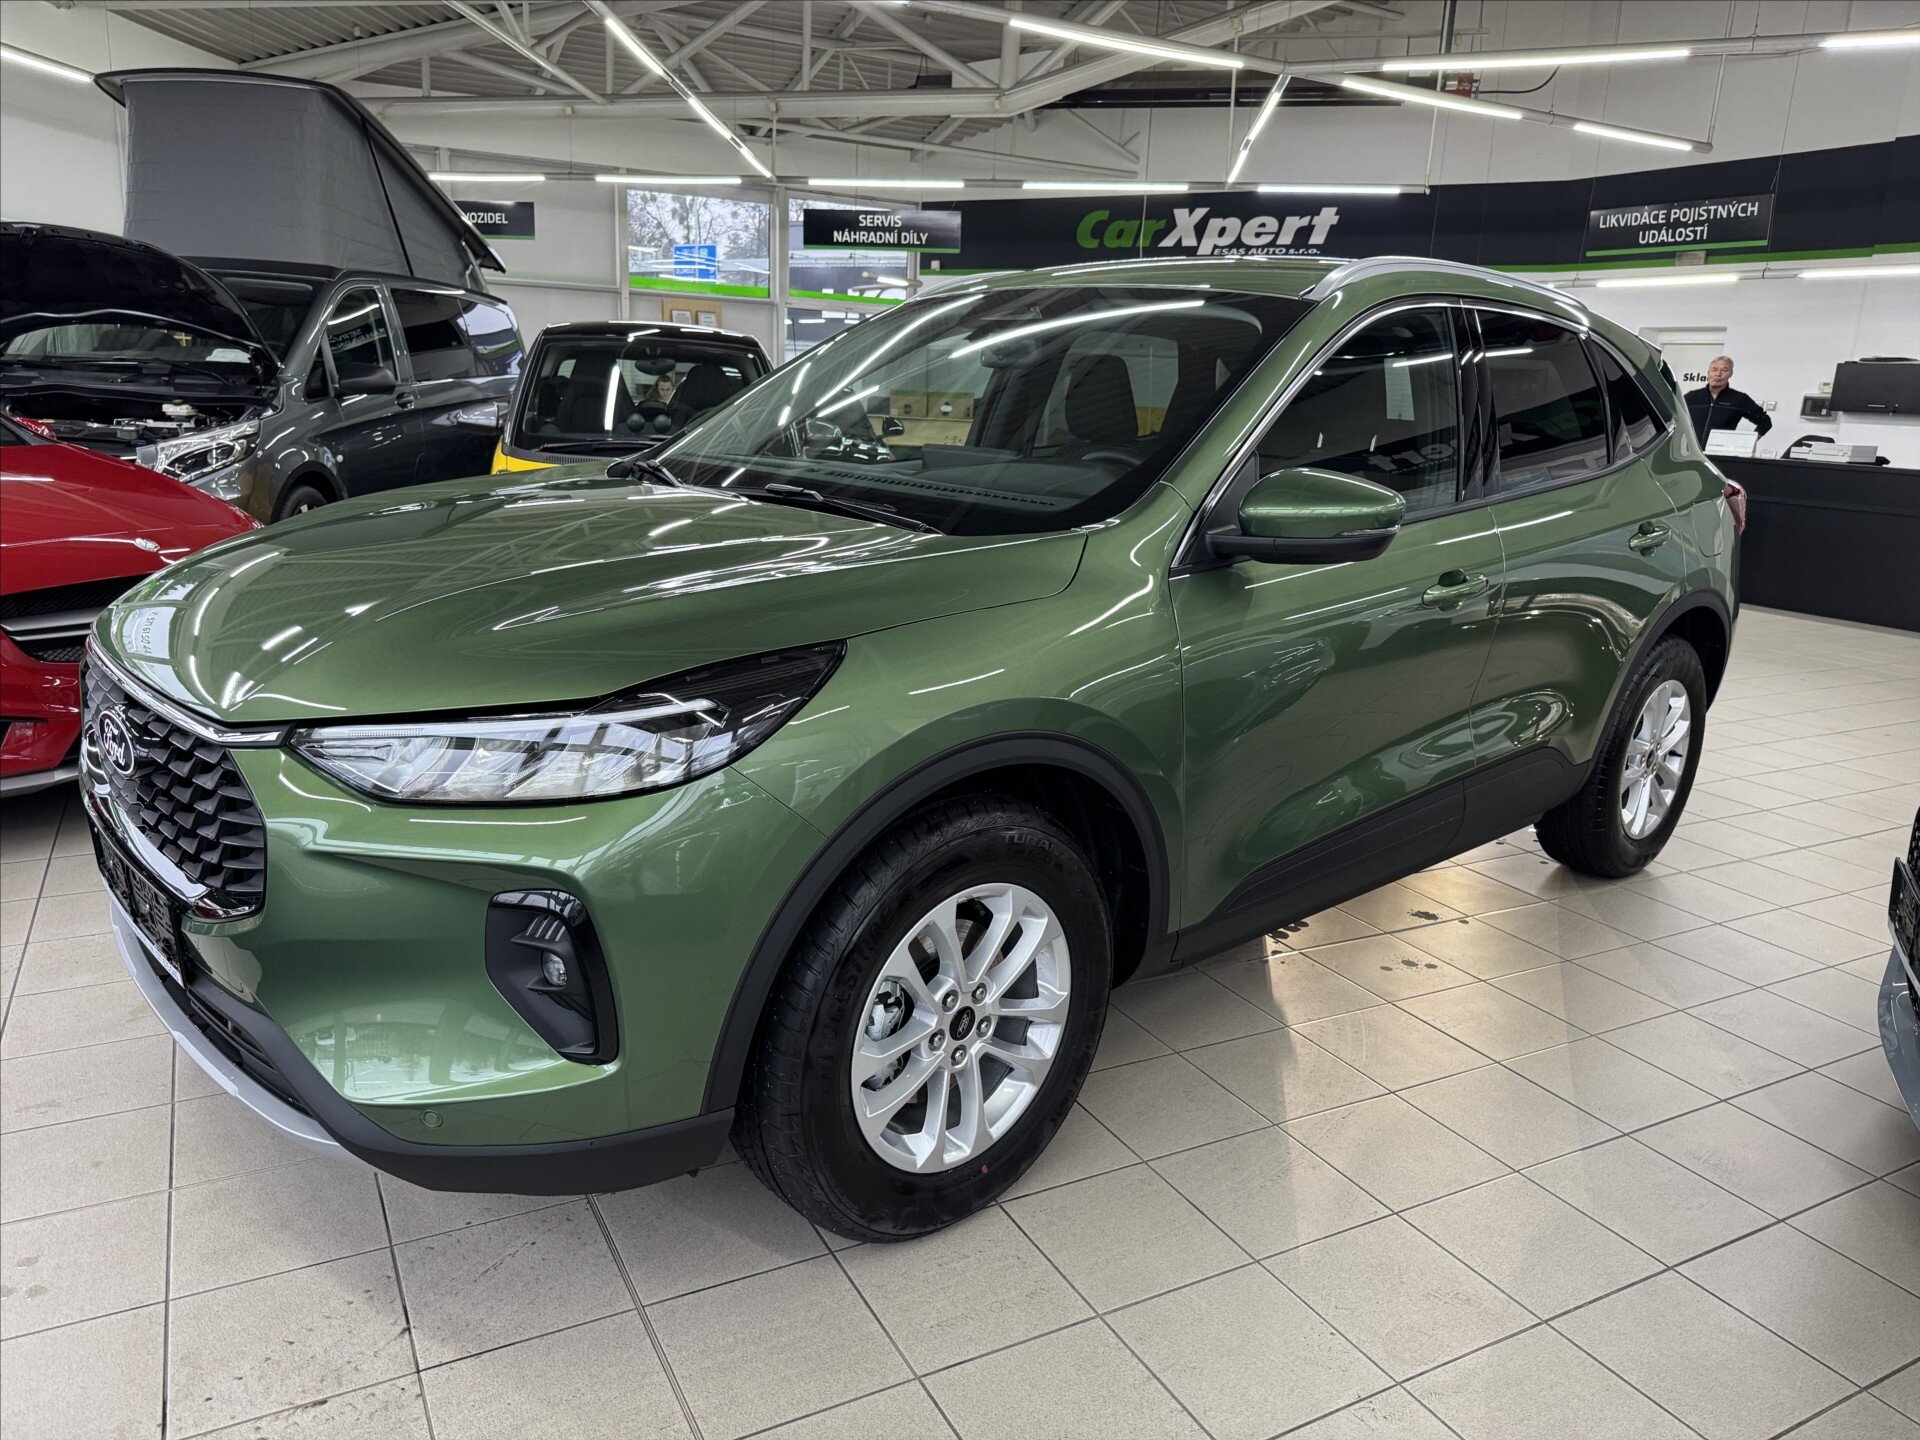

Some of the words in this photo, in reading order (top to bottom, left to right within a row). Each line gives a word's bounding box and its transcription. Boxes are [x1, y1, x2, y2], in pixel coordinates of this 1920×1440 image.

[858, 214, 902, 228] SERVIS
[1599, 209, 1667, 229] LIKVIDACE
[1669, 201, 1759, 224] POJISTNÝCH
[833, 229, 898, 244] NÁHRADNÍ
[901, 229, 929, 245] DÍLY
[1076, 206, 1340, 255] CarXpert
[1638, 223, 1709, 245] UDÁLOSTÍ
[1213, 247, 1246, 255] ESAS
[1248, 247, 1286, 255] AUTO
[1288, 247, 1321, 255] s.r.o.
[1682, 372, 1709, 382] Skla
[103, 717, 126, 767] Ford
